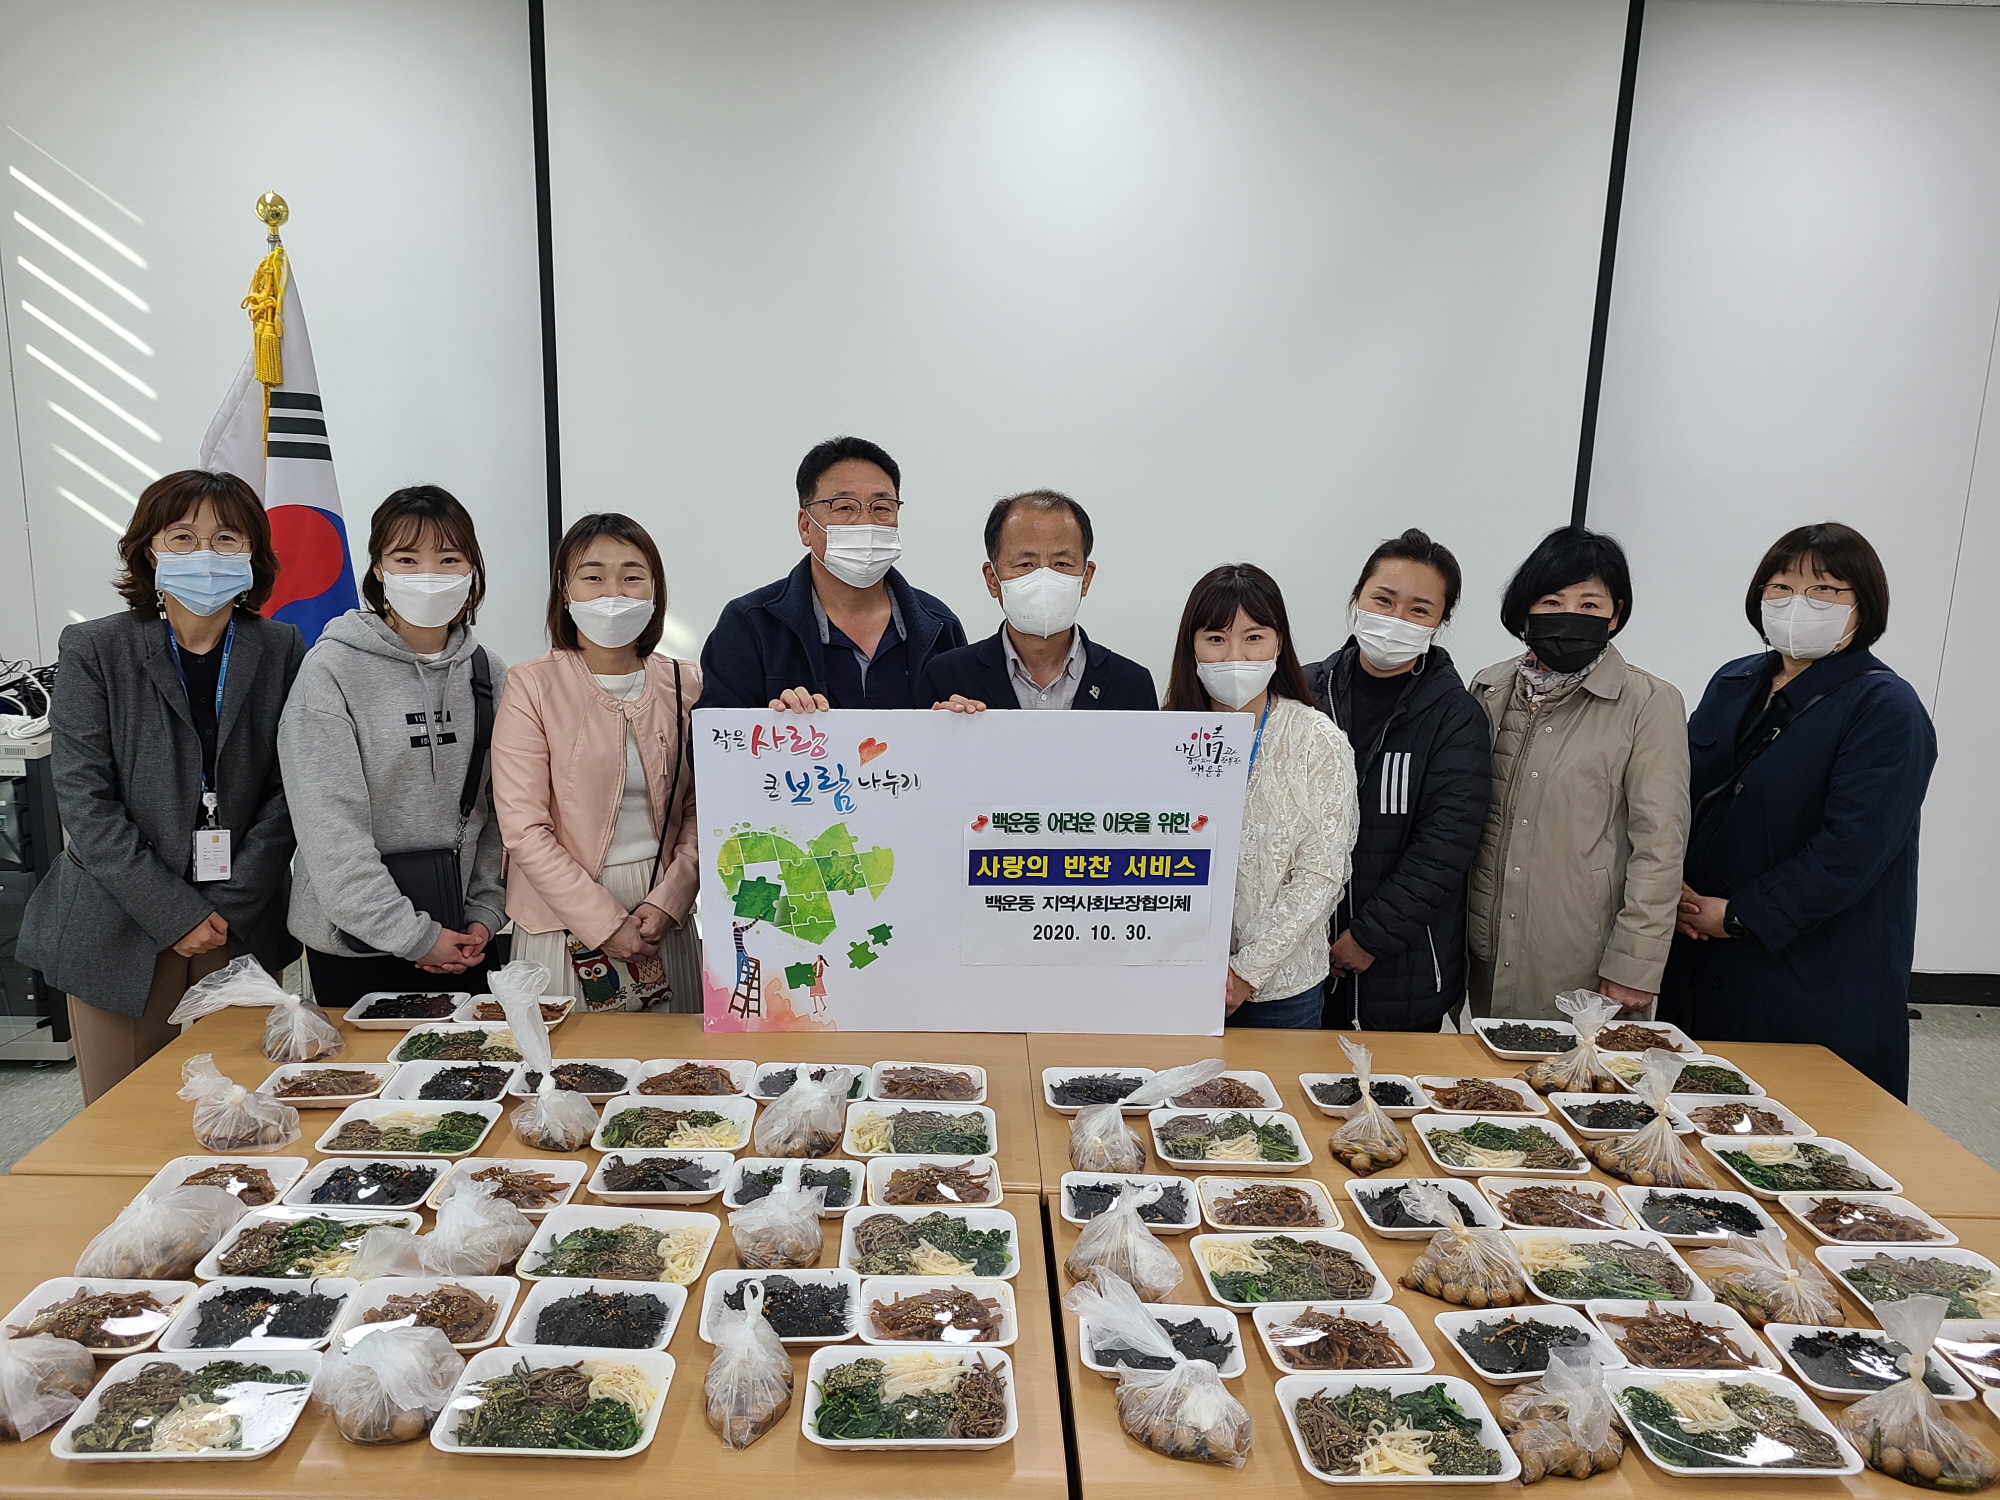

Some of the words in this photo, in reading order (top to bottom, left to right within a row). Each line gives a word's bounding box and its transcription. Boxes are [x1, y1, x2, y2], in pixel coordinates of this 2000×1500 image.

[712, 728, 746, 750] 작은
[751, 724, 827, 758] 사랑
[1191, 764, 1225, 778] 백운동
[763, 772, 779, 798] 큰
[785, 763, 856, 813] 보람
[857, 769, 920, 797] 나누기
[991, 812, 1041, 834] 백운동
[1047, 812, 1096, 834] 어려운
[1103, 812, 1152, 834] 이웃을
[1157, 812, 1190, 834] 위한
[976, 855, 1049, 879] 사랑의
[1064, 855, 1112, 879] 반찬
[1123, 855, 1197, 879] 서비스
[984, 894, 1036, 912] 백운동
[1042, 894, 1192, 913] 지역사회보장협의체
[1032, 924, 1080, 941] 2020.
[1090, 924, 1116, 941] 10.
[1125, 924, 1152, 941] 30.
